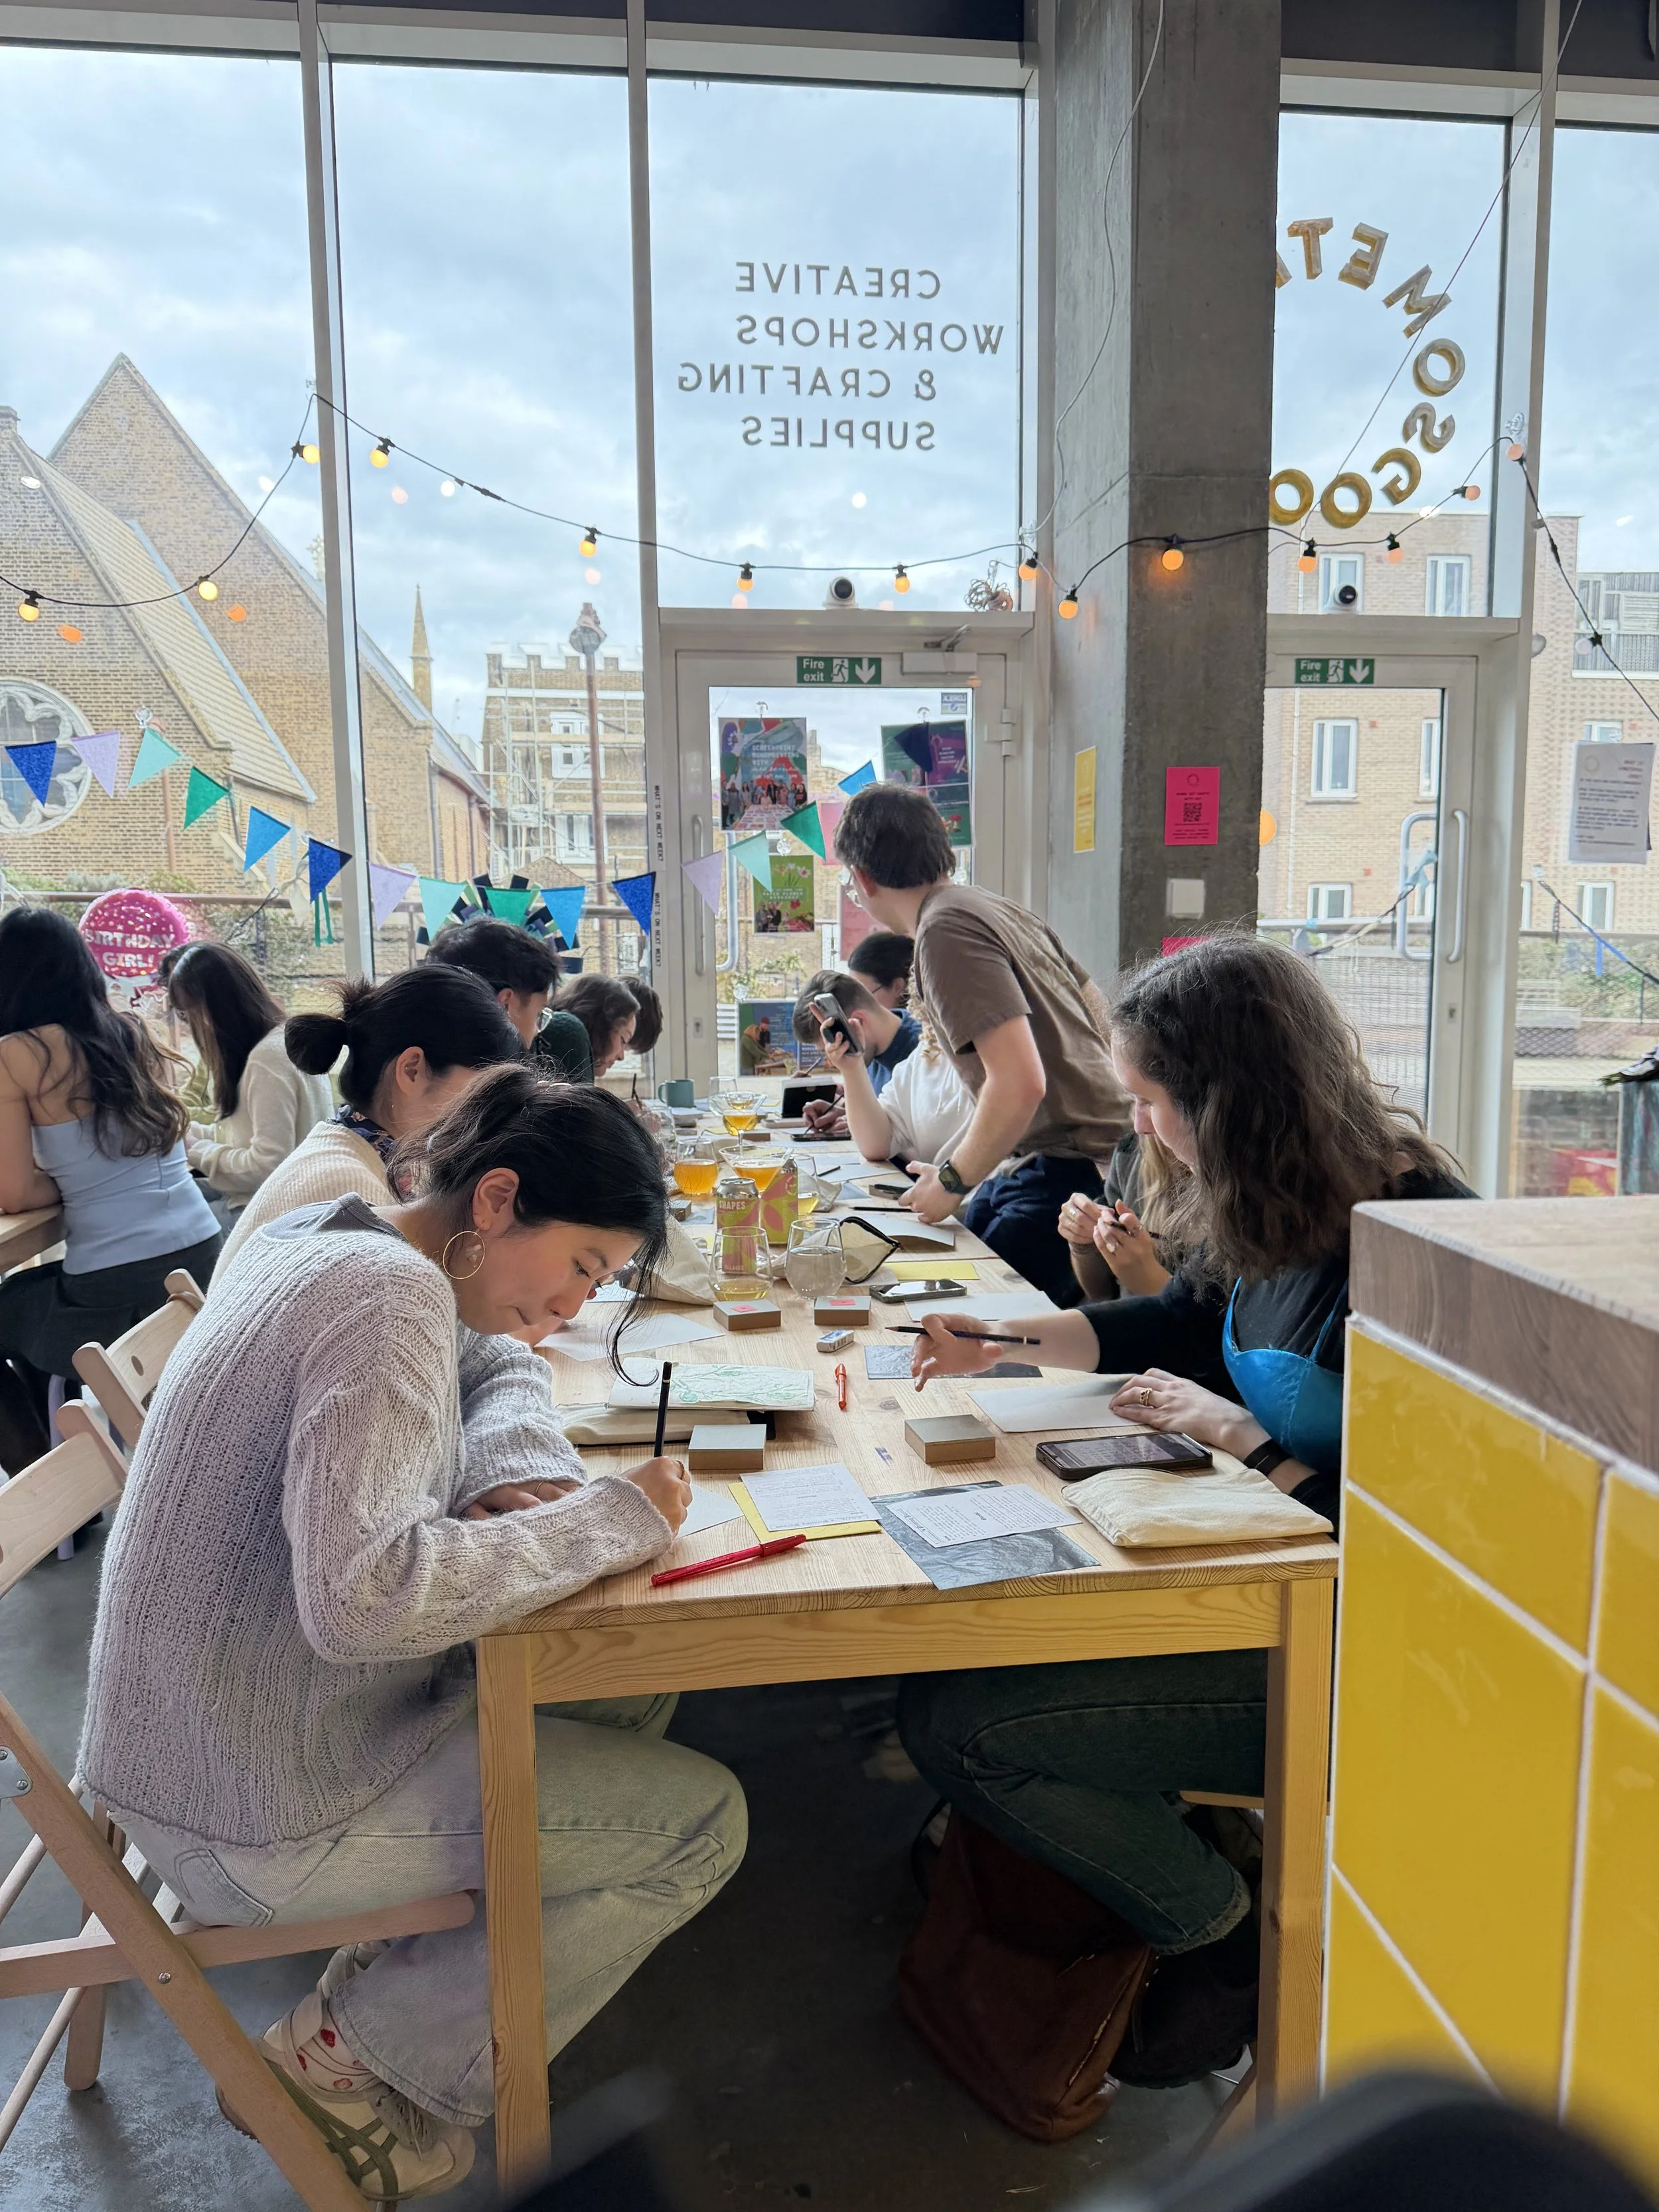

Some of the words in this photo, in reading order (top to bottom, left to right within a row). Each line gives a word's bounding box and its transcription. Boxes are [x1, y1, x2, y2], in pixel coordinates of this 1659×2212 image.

[802, 658, 825, 669] Fire
[1300, 659, 1322, 670] Fire
[802, 670, 825, 682] exit
[1300, 671, 1321, 682] exit
[656, 812, 662, 820] ON
[654, 919, 661, 927] ON
[102, 951, 155, 968] GIRL!
[719, 1199, 746, 1211] SHAPES
